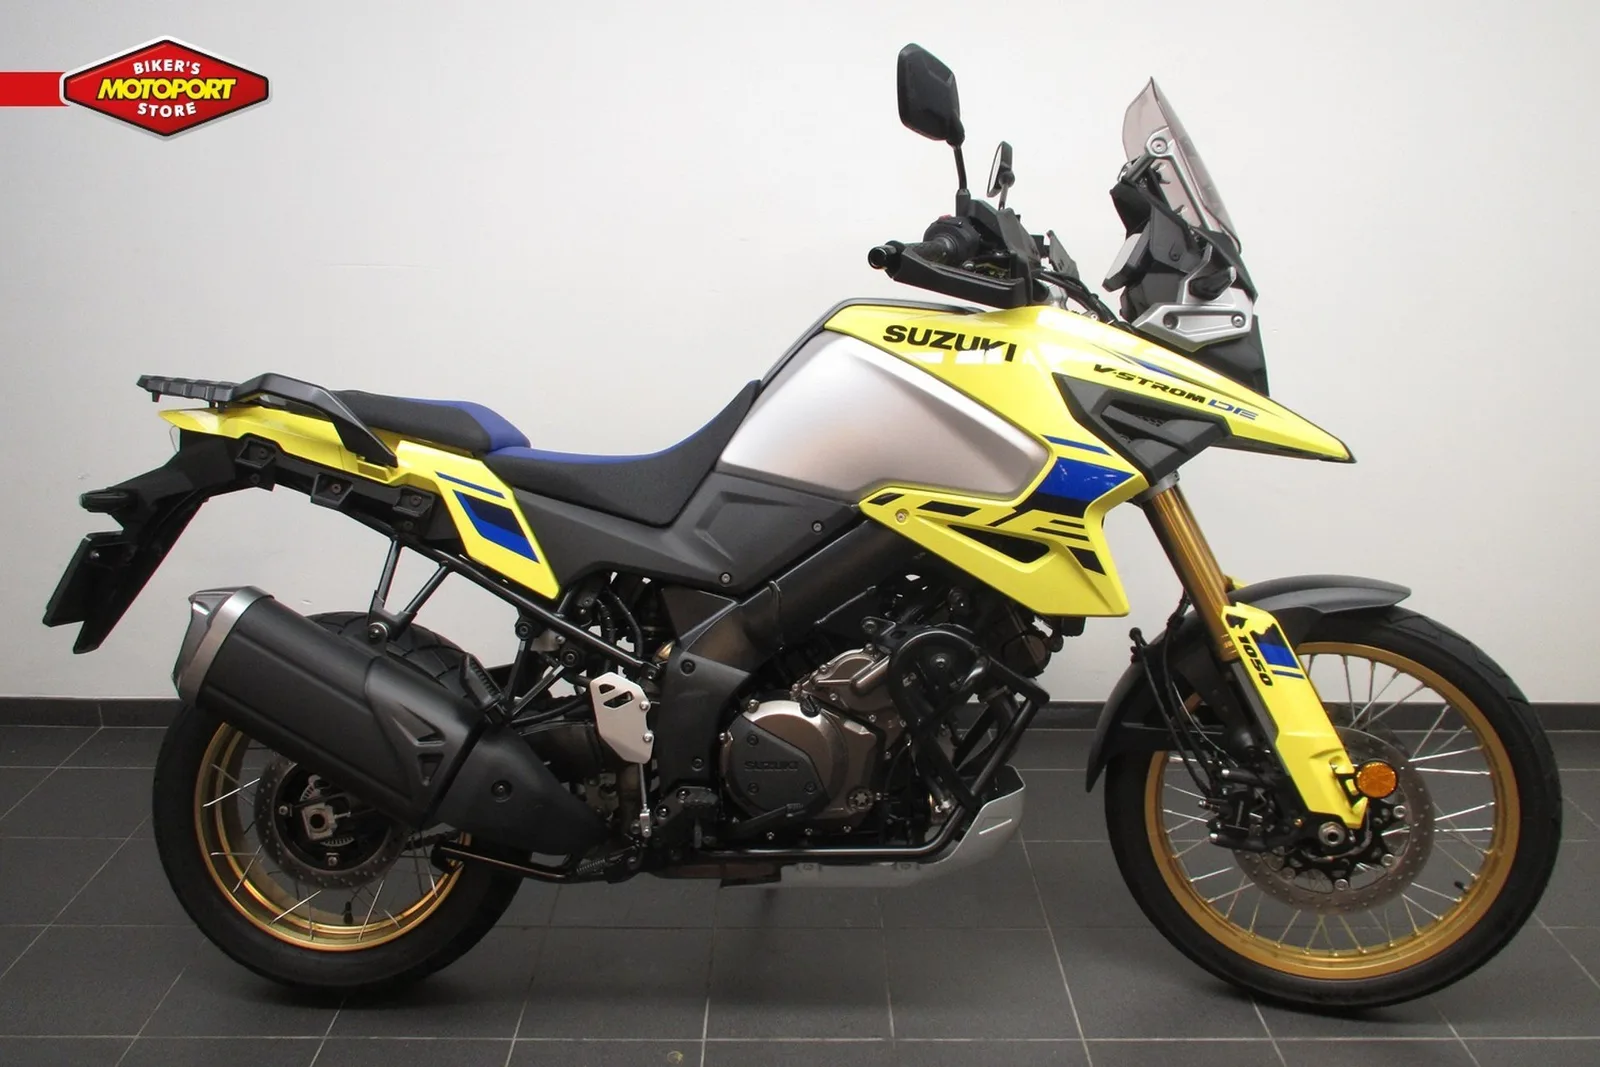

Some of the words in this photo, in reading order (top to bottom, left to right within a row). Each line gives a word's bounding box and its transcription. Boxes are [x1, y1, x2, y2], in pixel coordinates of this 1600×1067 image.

[883, 325, 1017, 362] SUZUKI
[1093, 364, 1206, 404] V-STROM
[1207, 399, 1259, 420] DE
[1238, 635, 1273, 686] 1050
[744, 760, 799, 772] SUZUKI
